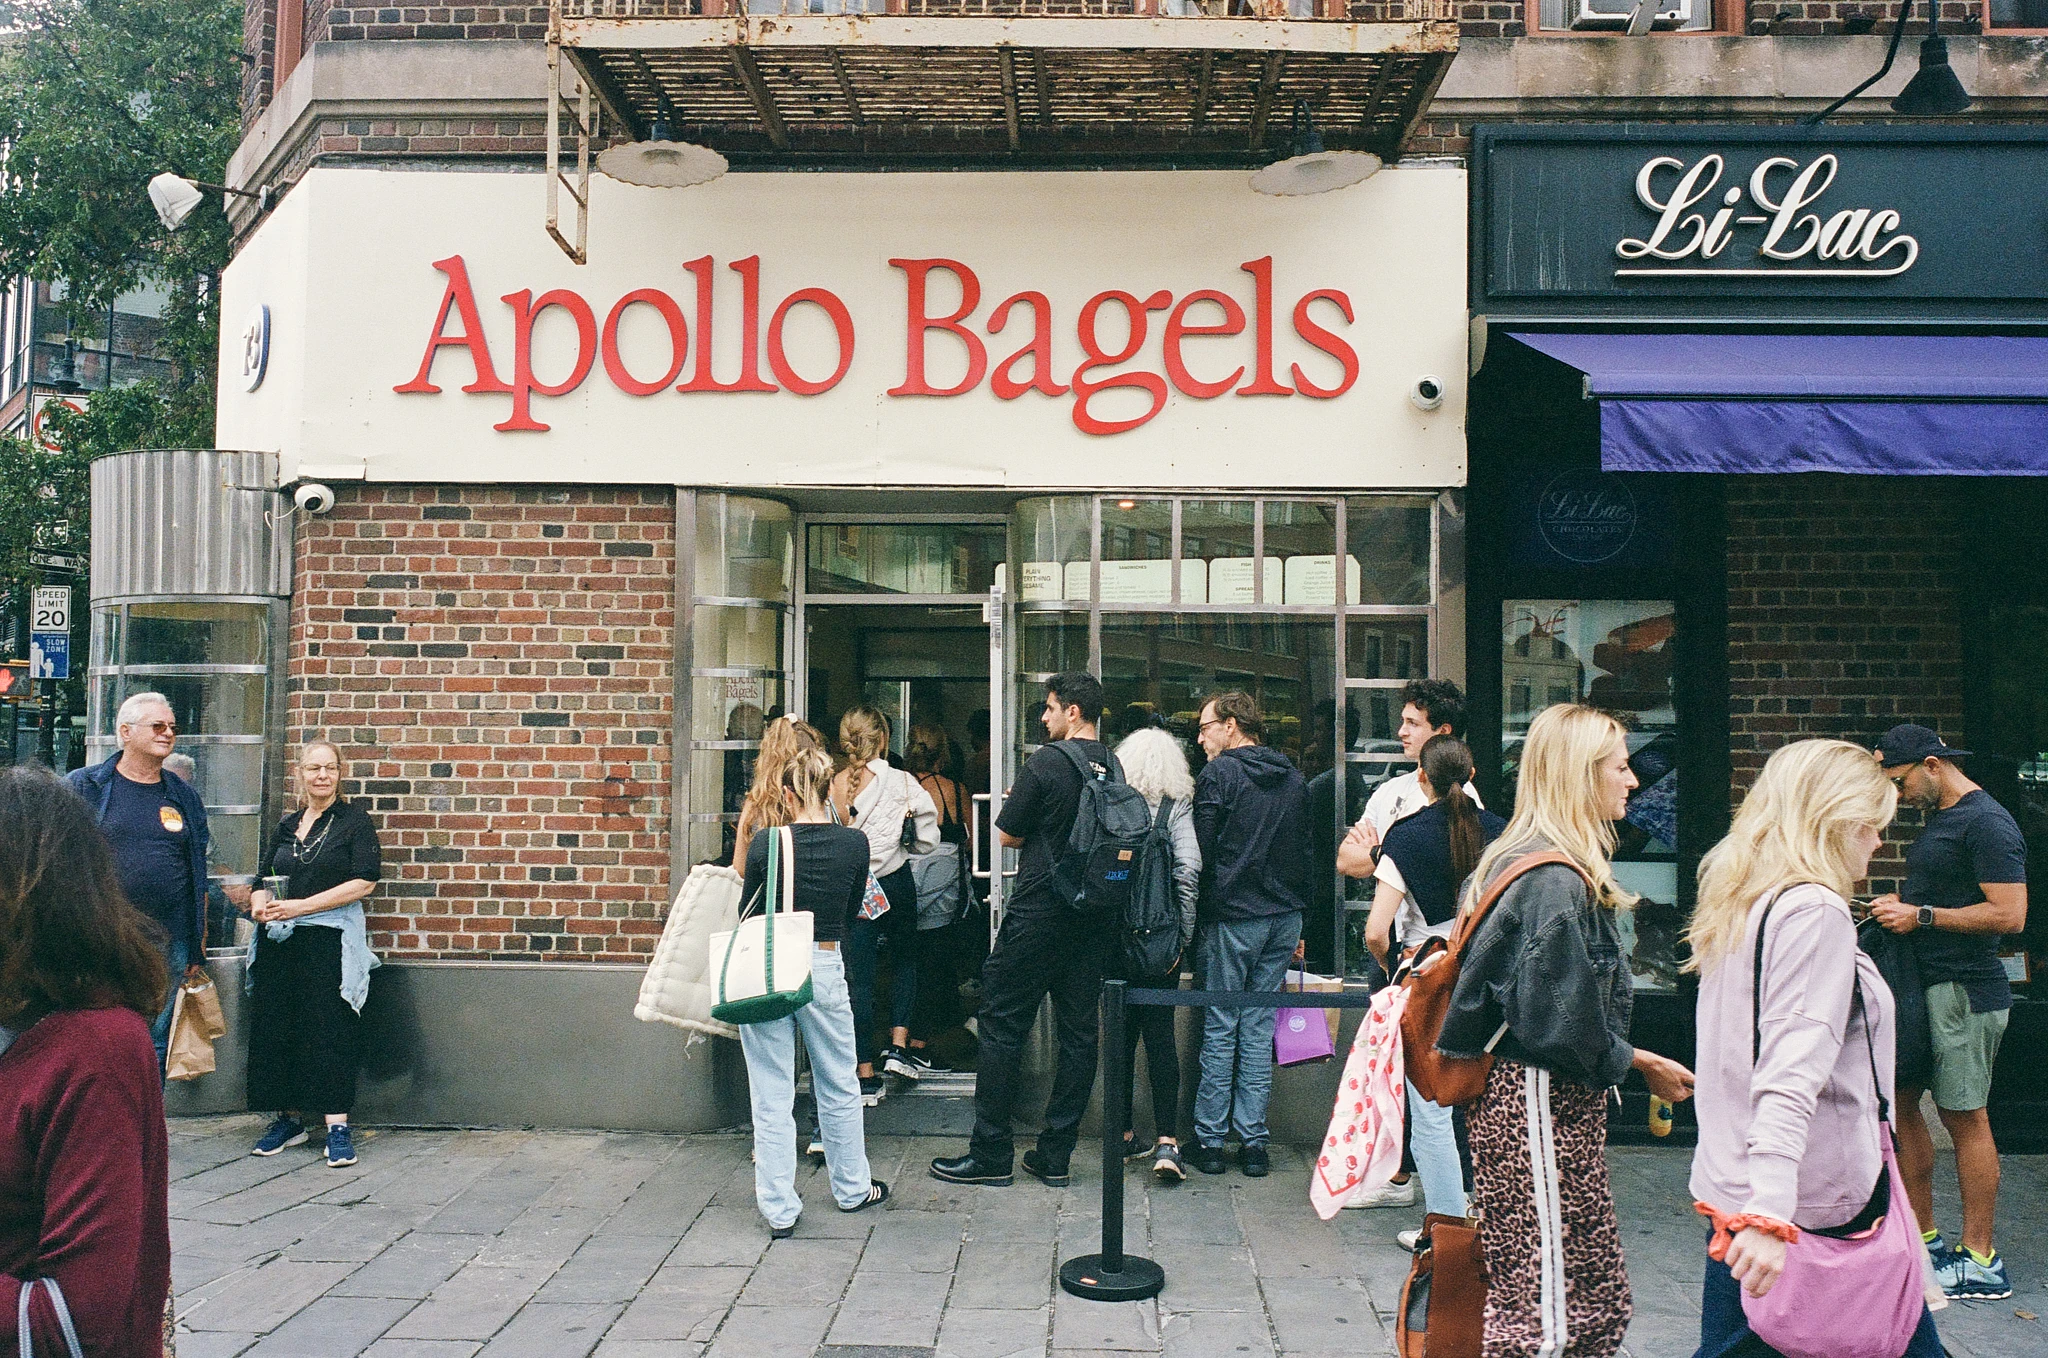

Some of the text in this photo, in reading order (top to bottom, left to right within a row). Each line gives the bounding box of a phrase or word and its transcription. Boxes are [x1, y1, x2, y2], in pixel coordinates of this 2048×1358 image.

[1614, 153, 1918, 276] Li-Lac
[392, 254, 1360, 437] Apollo Bagels
[32, 553, 85, 568] ONE WAY
[36, 591, 67, 599] SPEED
[38, 600, 64, 608] LIMIT
[37, 610, 65, 627] 20
[46, 638, 66, 646] SLOW
[726, 685, 759, 701] Bagels
